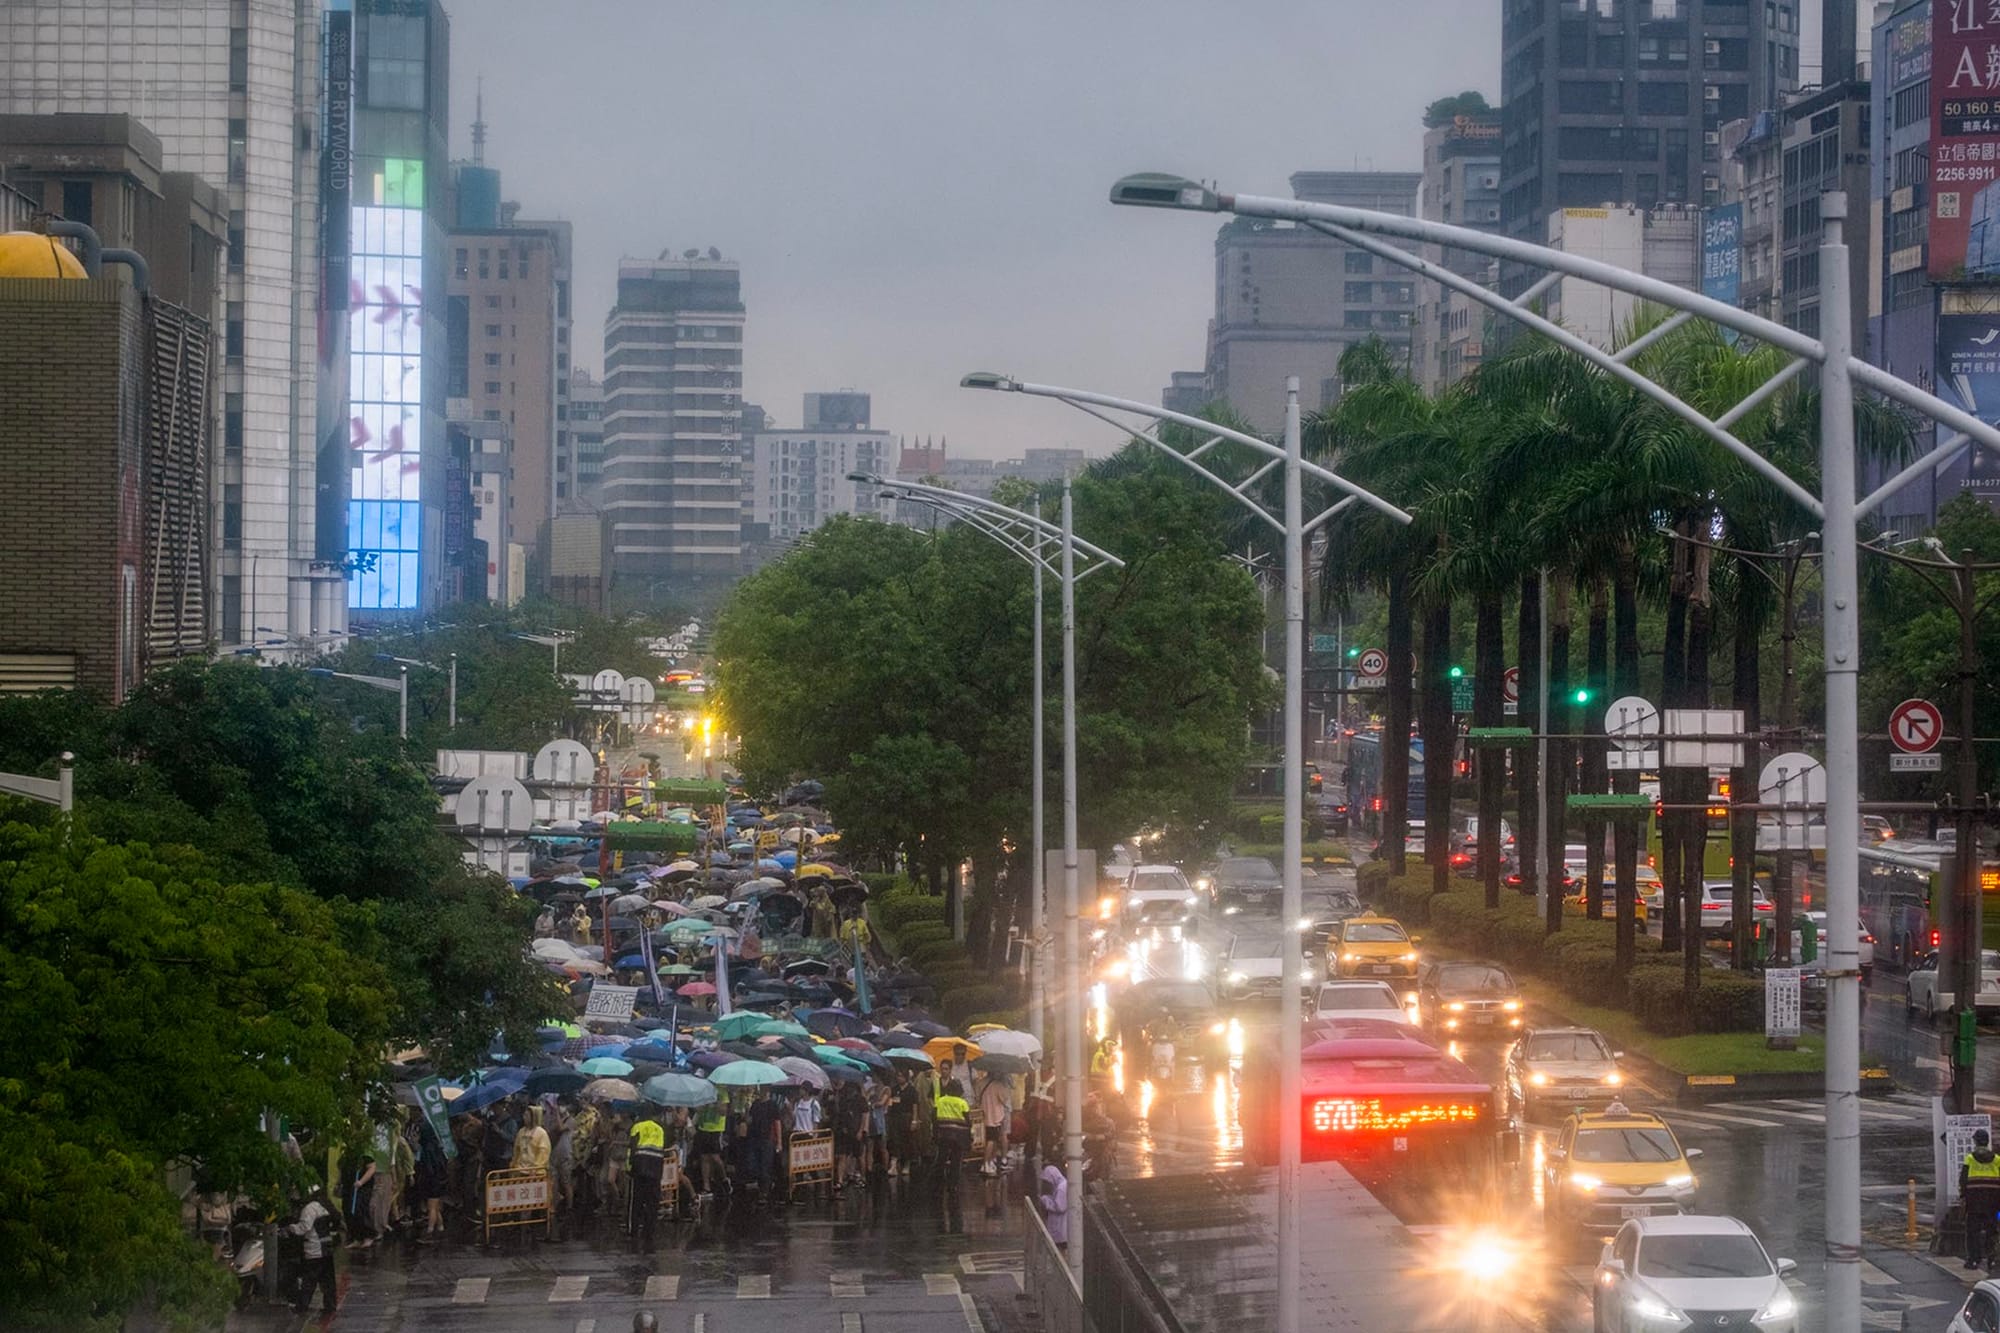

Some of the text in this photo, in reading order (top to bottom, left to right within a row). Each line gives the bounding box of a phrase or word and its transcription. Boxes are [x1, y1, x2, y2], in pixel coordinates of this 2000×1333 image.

[331, 81, 348, 190] PRTYWORLD
[1936, 166, 1995, 181] 2256-9911
[1363, 658, 1382, 669] 40
[1314, 1100, 1358, 1131] 670
